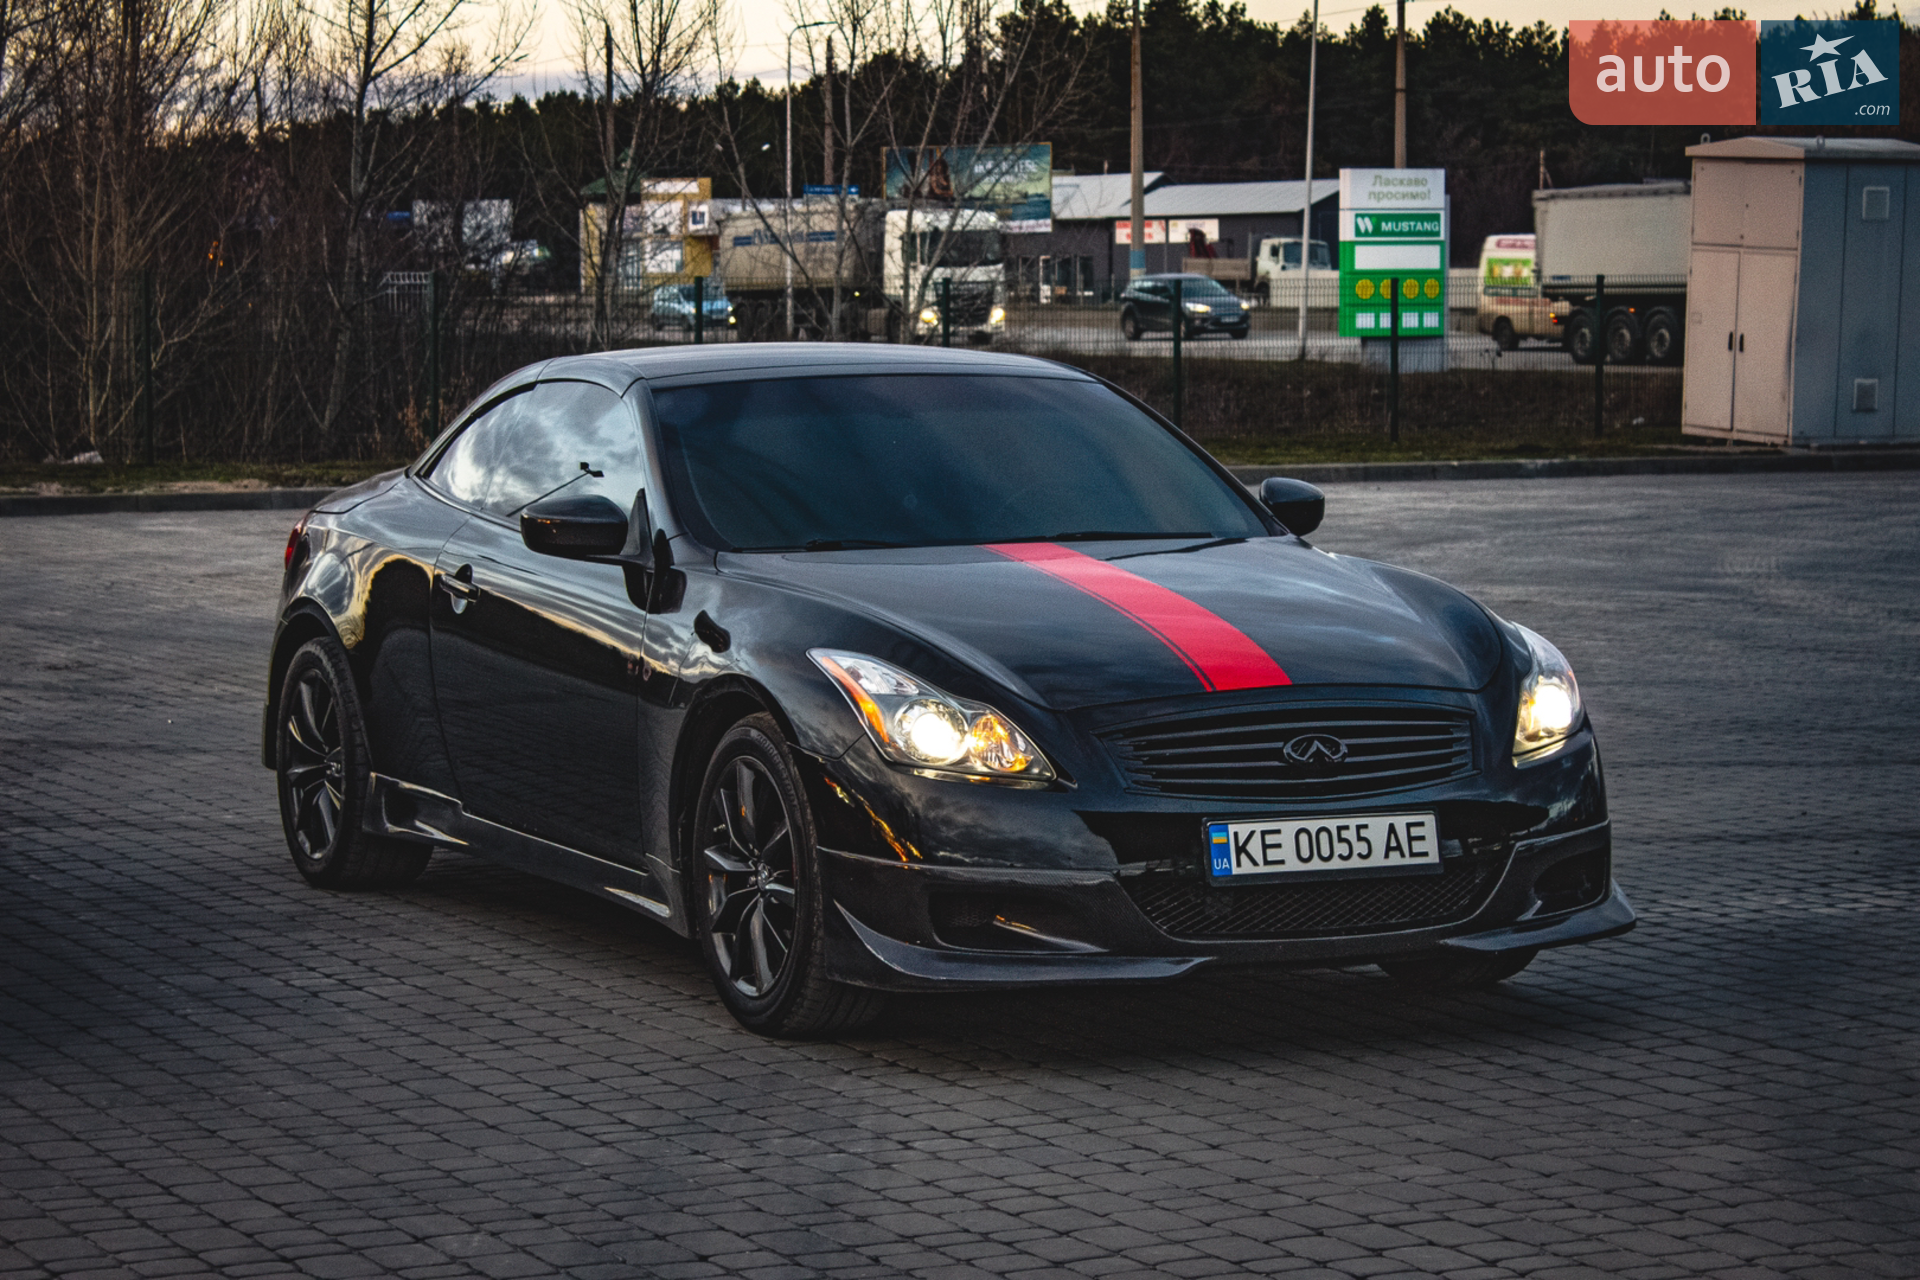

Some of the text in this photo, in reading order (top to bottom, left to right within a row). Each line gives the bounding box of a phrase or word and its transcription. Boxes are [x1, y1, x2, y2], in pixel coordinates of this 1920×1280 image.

[1372, 175, 1428, 187] Ласкаво
[1368, 189, 1432, 203] просимо!
[1381, 220, 1440, 232] MUSTANG
[1233, 820, 1430, 868] KE 0055 AE
[1213, 858, 1230, 870] UA
